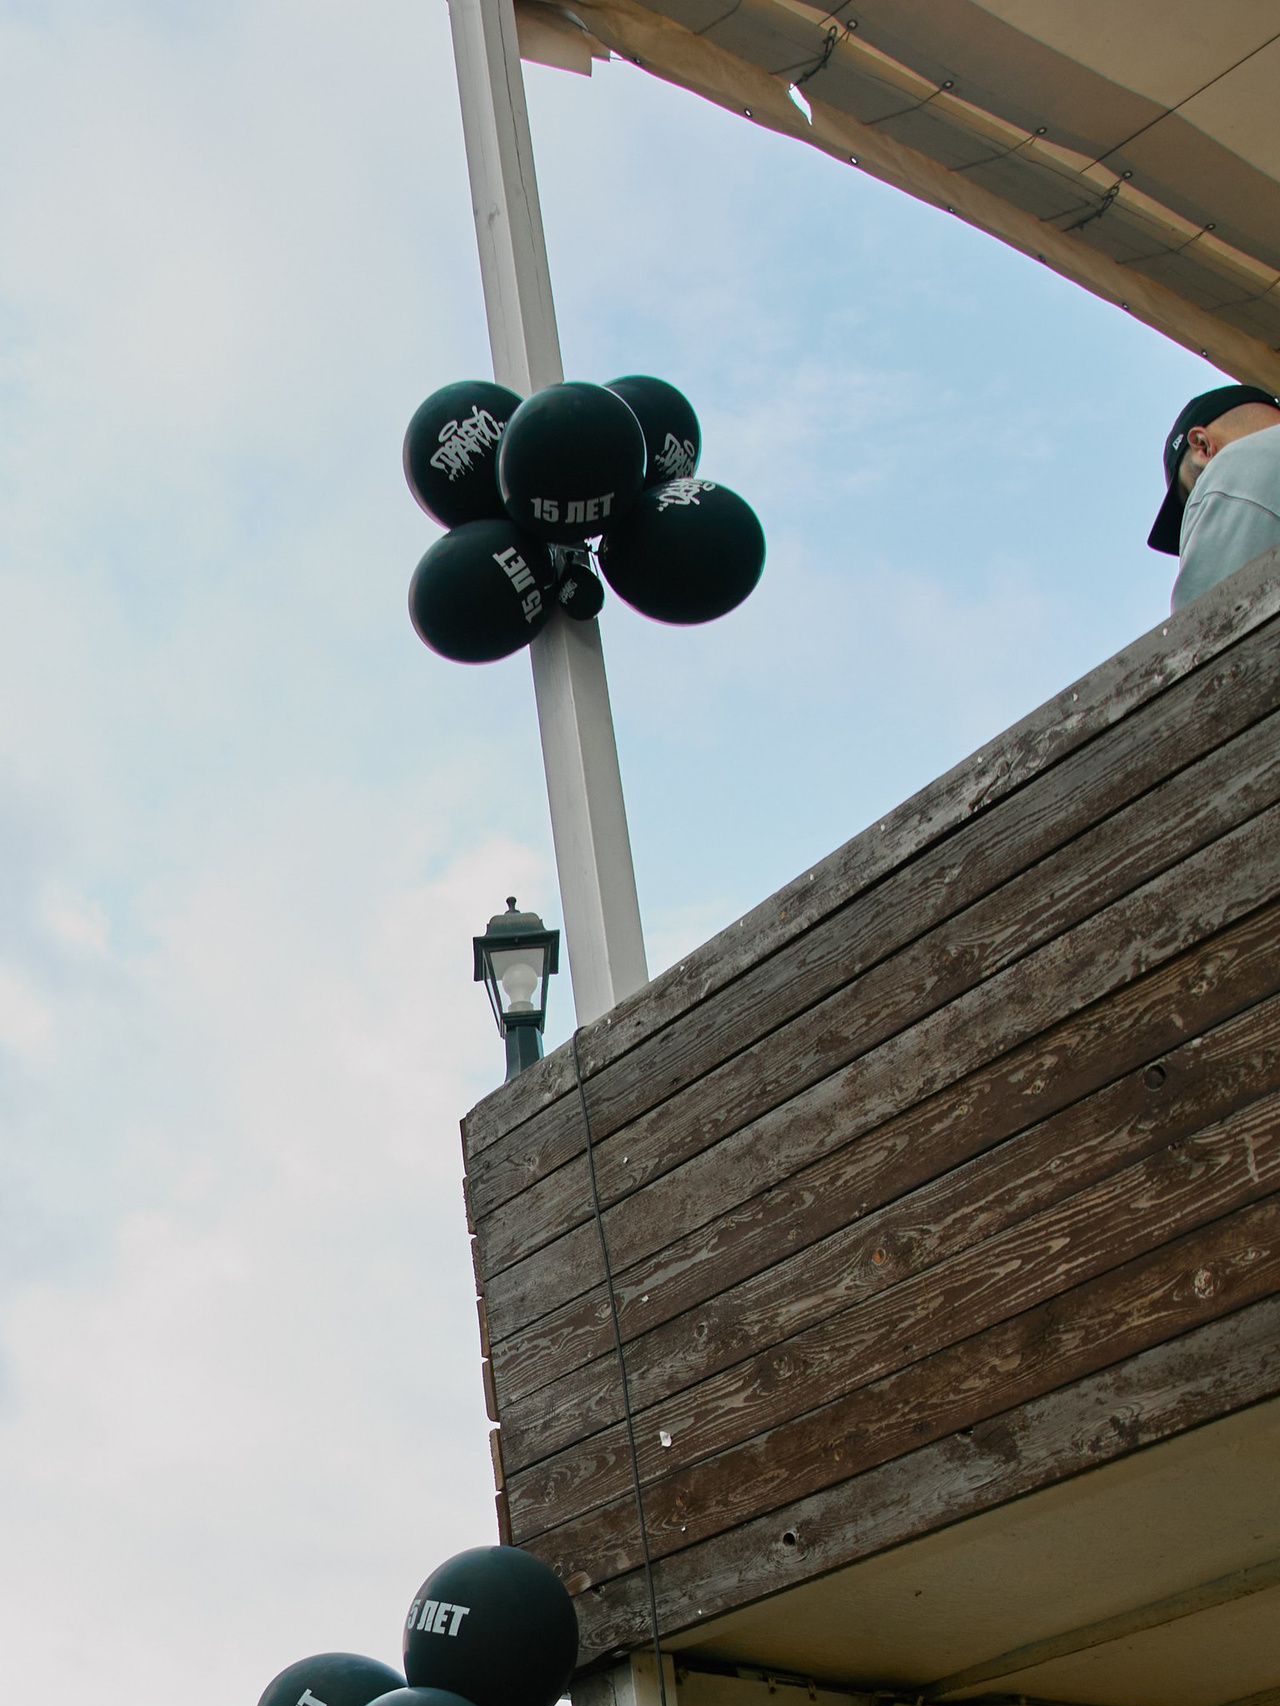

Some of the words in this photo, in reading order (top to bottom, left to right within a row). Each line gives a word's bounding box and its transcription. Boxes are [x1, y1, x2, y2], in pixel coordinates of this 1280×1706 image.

[531, 497, 559, 523] 15
[565, 491, 616, 524] ЛЕТ
[492, 546, 536, 592] ЛЕТ
[520, 586, 544, 624] 15
[416, 1599, 470, 1637] ЛЕТ
